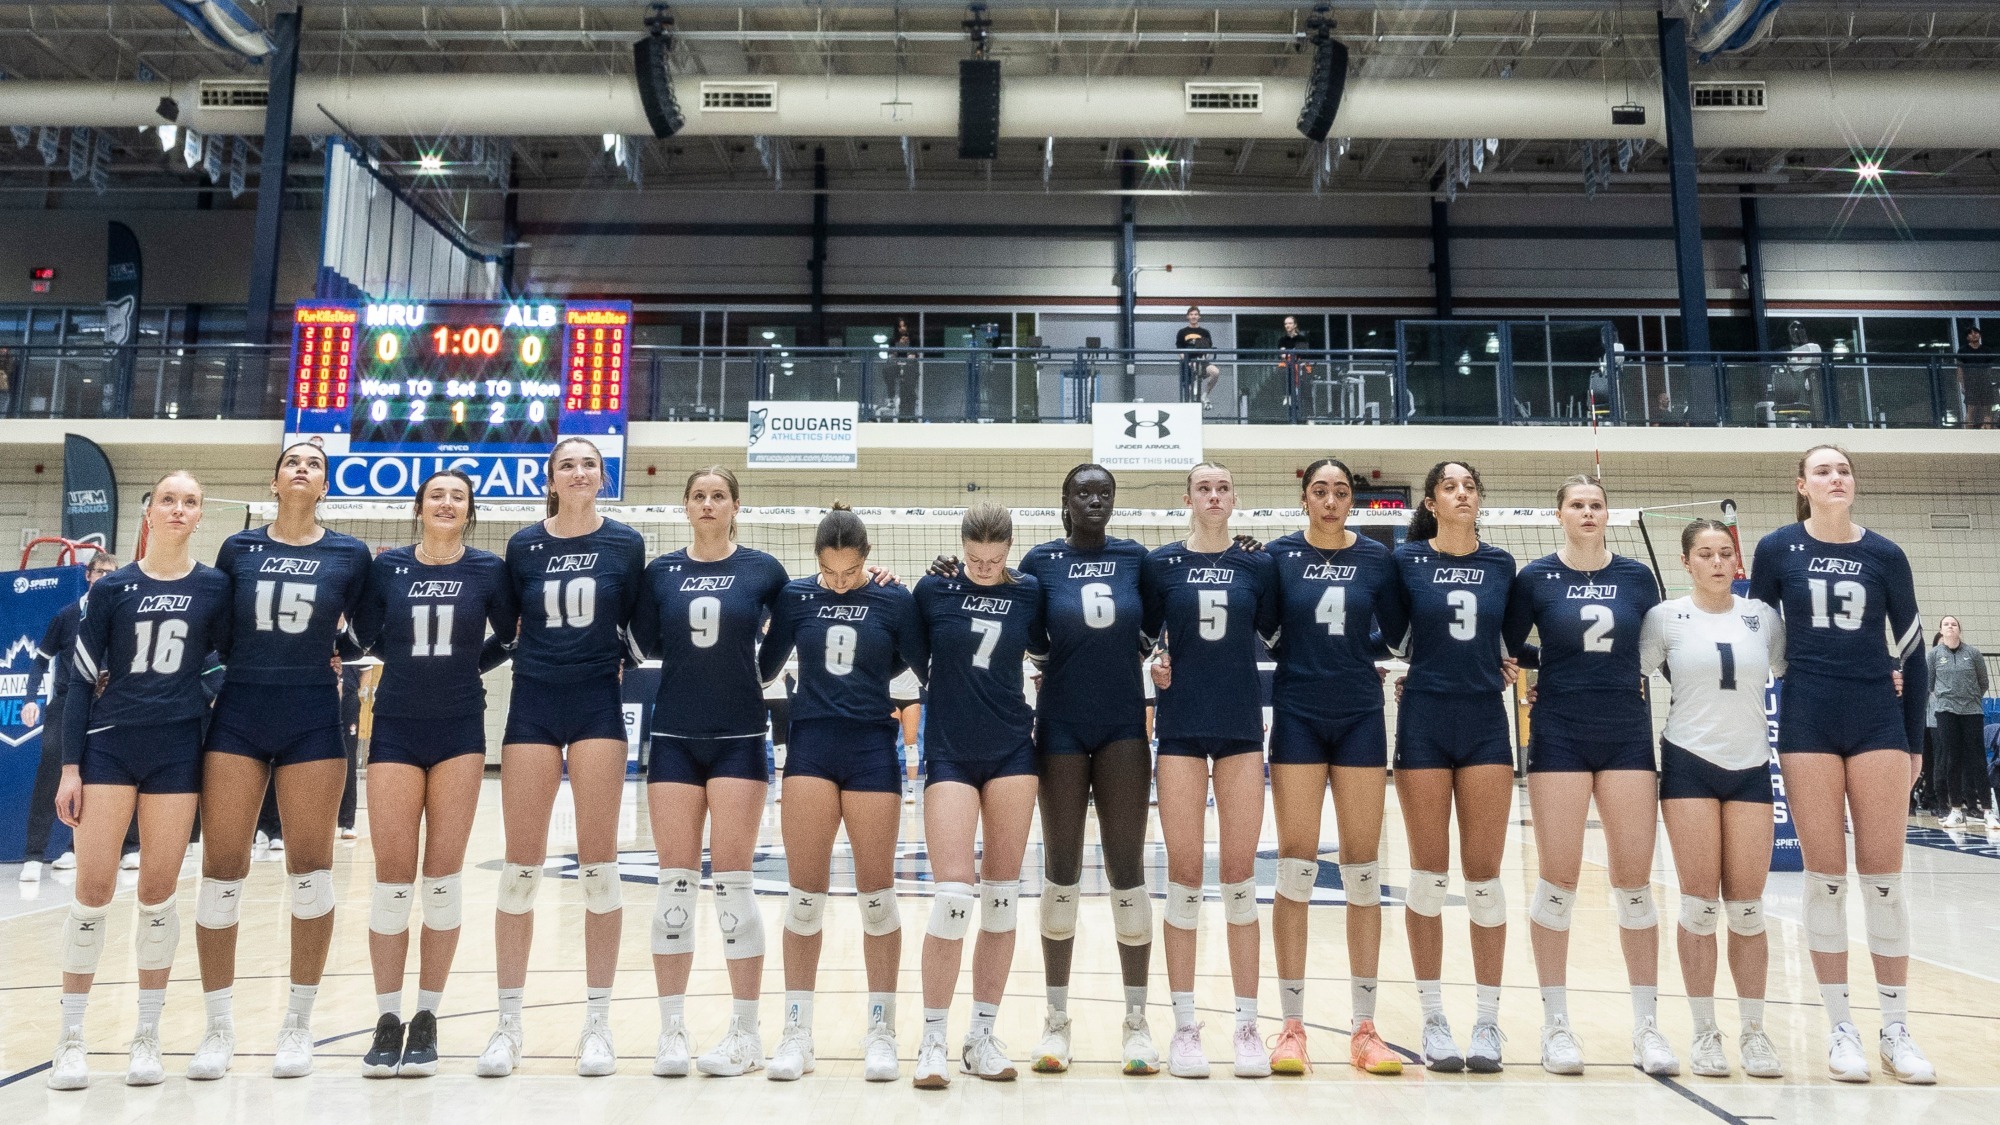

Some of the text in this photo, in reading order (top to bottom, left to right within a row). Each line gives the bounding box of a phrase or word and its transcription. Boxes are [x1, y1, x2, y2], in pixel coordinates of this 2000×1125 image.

[367, 304, 425, 326] MRU
[503, 304, 556, 327] ALB
[305, 326, 315, 339] 2
[433, 326, 500, 355] 1:00
[577, 328, 585, 340] 6
[305, 340, 314, 352] 3
[378, 332, 399, 361] 0
[521, 335, 542, 364] 0
[361, 380, 561, 397] Won TO Set TO Won
[371, 399, 545, 424] 0 2 1 2 0
[771, 418, 852, 431] COUGARS
[771, 433, 852, 441] ATHLETICS FUND
[1100, 457, 1140, 465] PROTECT
[1143, 457, 1163, 465] THIS
[1019, 509, 1056, 517] COUGARS
[1366, 509, 1403, 517] COUGARS
[260, 557, 321, 576] MRU
[545, 552, 599, 574] MRU
[1068, 561, 1117, 579] MRU
[1302, 564, 1358, 581] MRU
[1807, 557, 1863, 576] MRU
[29, 578, 59, 588] SPIETH
[679, 574, 736, 592] MRU
[1186, 568, 1235, 584] MRU
[1433, 567, 1485, 585] MRU
[407, 580, 463, 598] MRU
[1566, 584, 1618, 600] MRU
[137, 594, 192, 613] MRU
[254, 579, 318, 634] 15
[542, 576, 597, 629] 10
[816, 605, 870, 622] MRU
[961, 594, 1013, 616] MRU
[1080, 581, 1117, 629] 6
[1314, 585, 1348, 637] 4
[1807, 578, 1868, 631] 13
[688, 595, 722, 649] 9
[1196, 589, 1229, 643] 5
[1446, 589, 1479, 642] 3
[410, 604, 455, 657] 11
[1579, 603, 1616, 653] 2
[129, 618, 189, 675] 16
[824, 624, 859, 677] 8
[970, 617, 1003, 670] 7
[1715, 641, 1738, 692] 1
